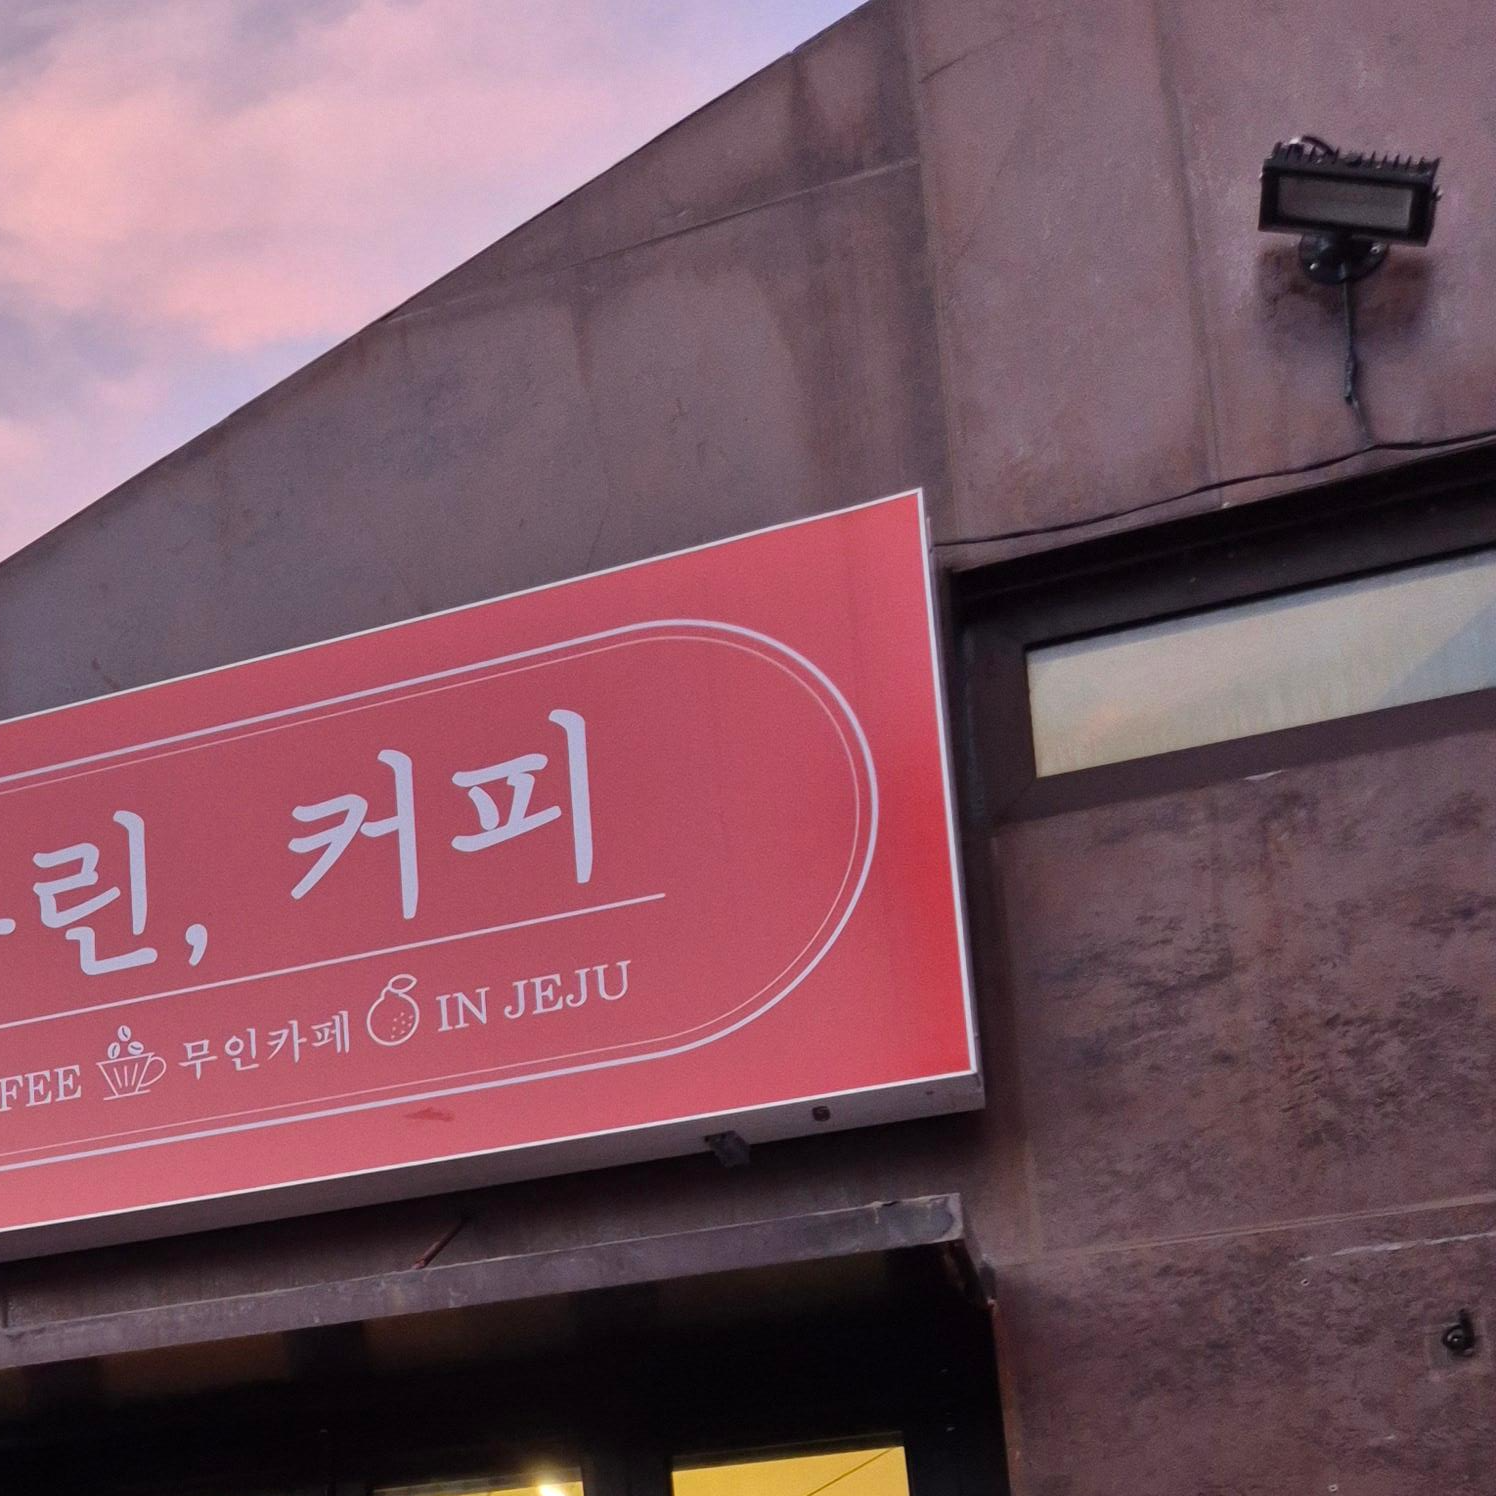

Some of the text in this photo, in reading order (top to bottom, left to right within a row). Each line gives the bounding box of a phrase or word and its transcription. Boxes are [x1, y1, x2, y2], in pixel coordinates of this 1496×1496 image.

[290, 710, 594, 920] 커피
[177, 1011, 350, 1076] 무인카페
[438, 987, 489, 1032] IN
[503, 961, 630, 1019] JEJU
